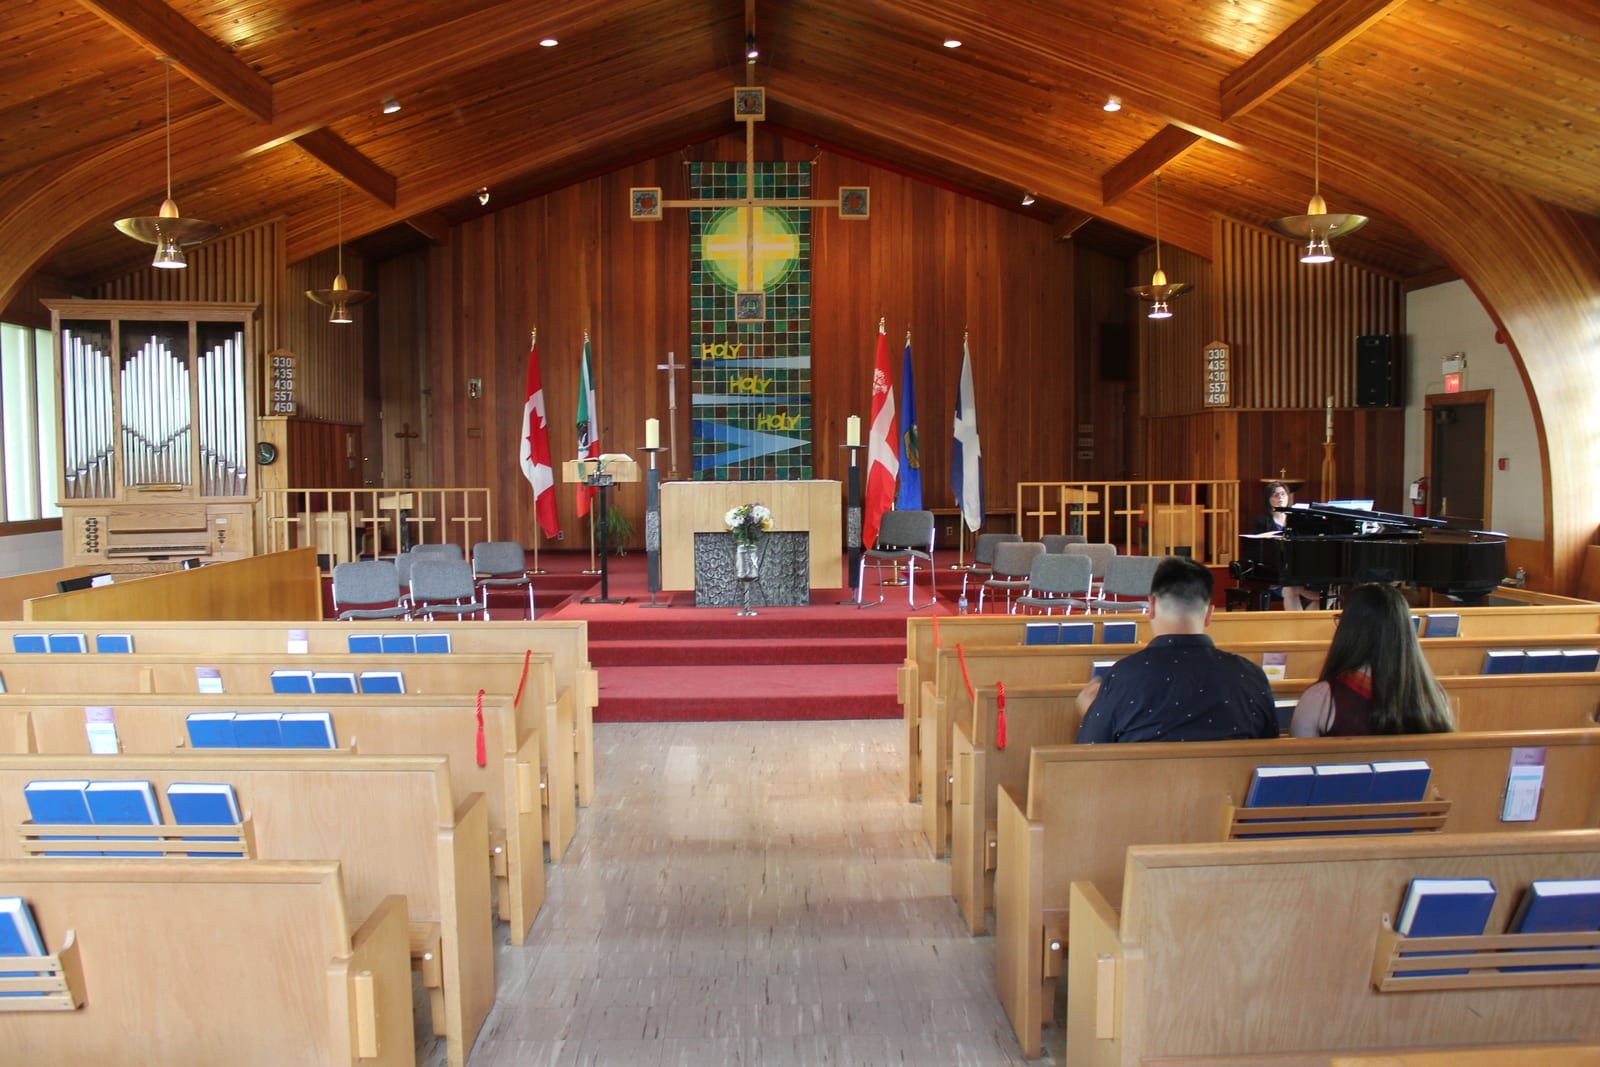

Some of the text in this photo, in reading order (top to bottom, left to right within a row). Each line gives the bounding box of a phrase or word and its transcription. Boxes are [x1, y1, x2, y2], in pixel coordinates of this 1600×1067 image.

[701, 341, 743, 360] HOLY
[1208, 349, 1225, 360] 330
[272, 357, 292, 367] 330
[1208, 360, 1225, 370] 435
[274, 368, 293, 379] 435
[1208, 371, 1226, 381] 430
[274, 380, 293, 390] 430
[730, 375, 773, 394] HOLY
[1209, 382, 1226, 393] 557
[274, 391, 293, 401] 557
[1208, 393, 1225, 404] 450
[274, 402, 293, 412] 450
[756, 411, 801, 431] HOLY
